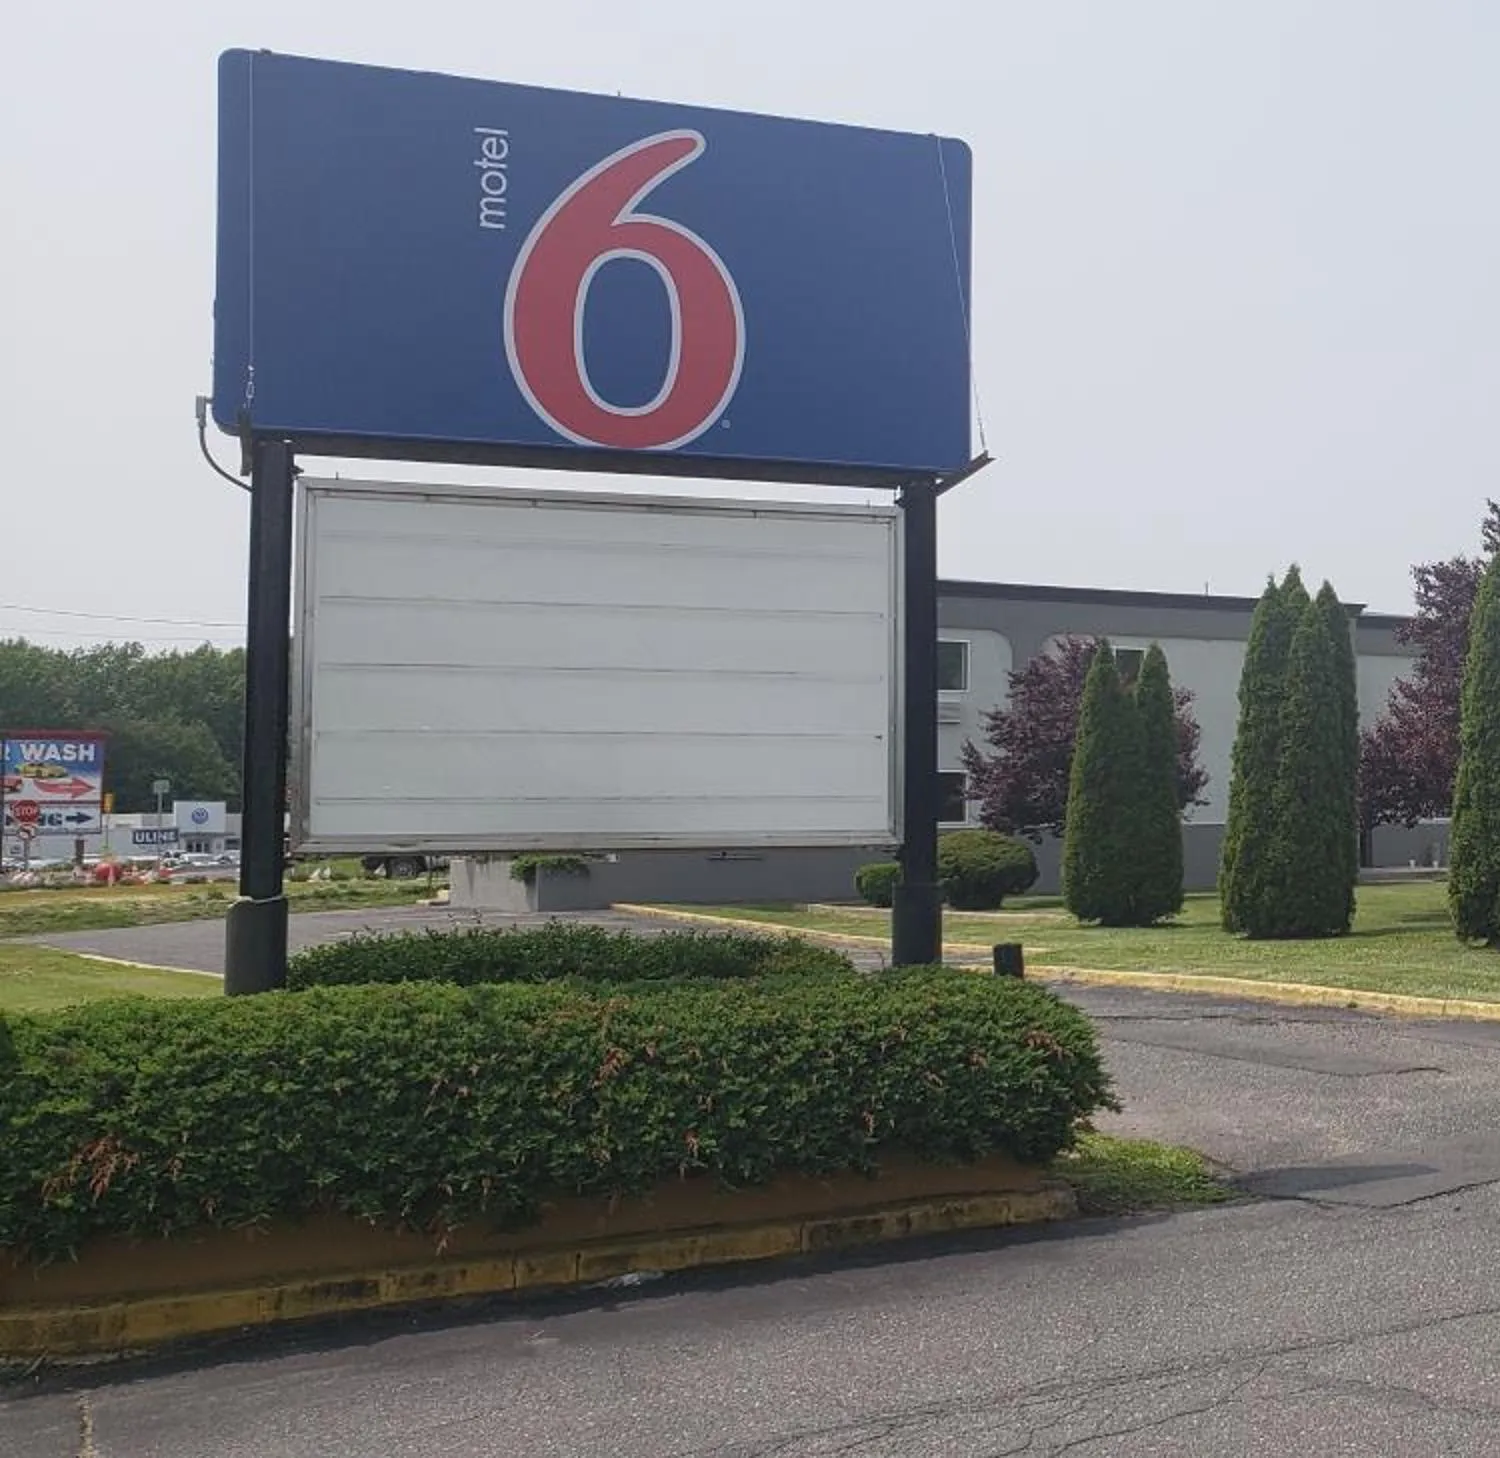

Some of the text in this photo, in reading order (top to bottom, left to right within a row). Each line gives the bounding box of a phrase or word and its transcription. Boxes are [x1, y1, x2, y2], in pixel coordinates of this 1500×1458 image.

[474, 127, 509, 229] motel
[503, 129, 746, 451] 6
[19, 743, 96, 761] WASH
[13, 806, 38, 817] STOP
[135, 830, 177, 843] ULINE
